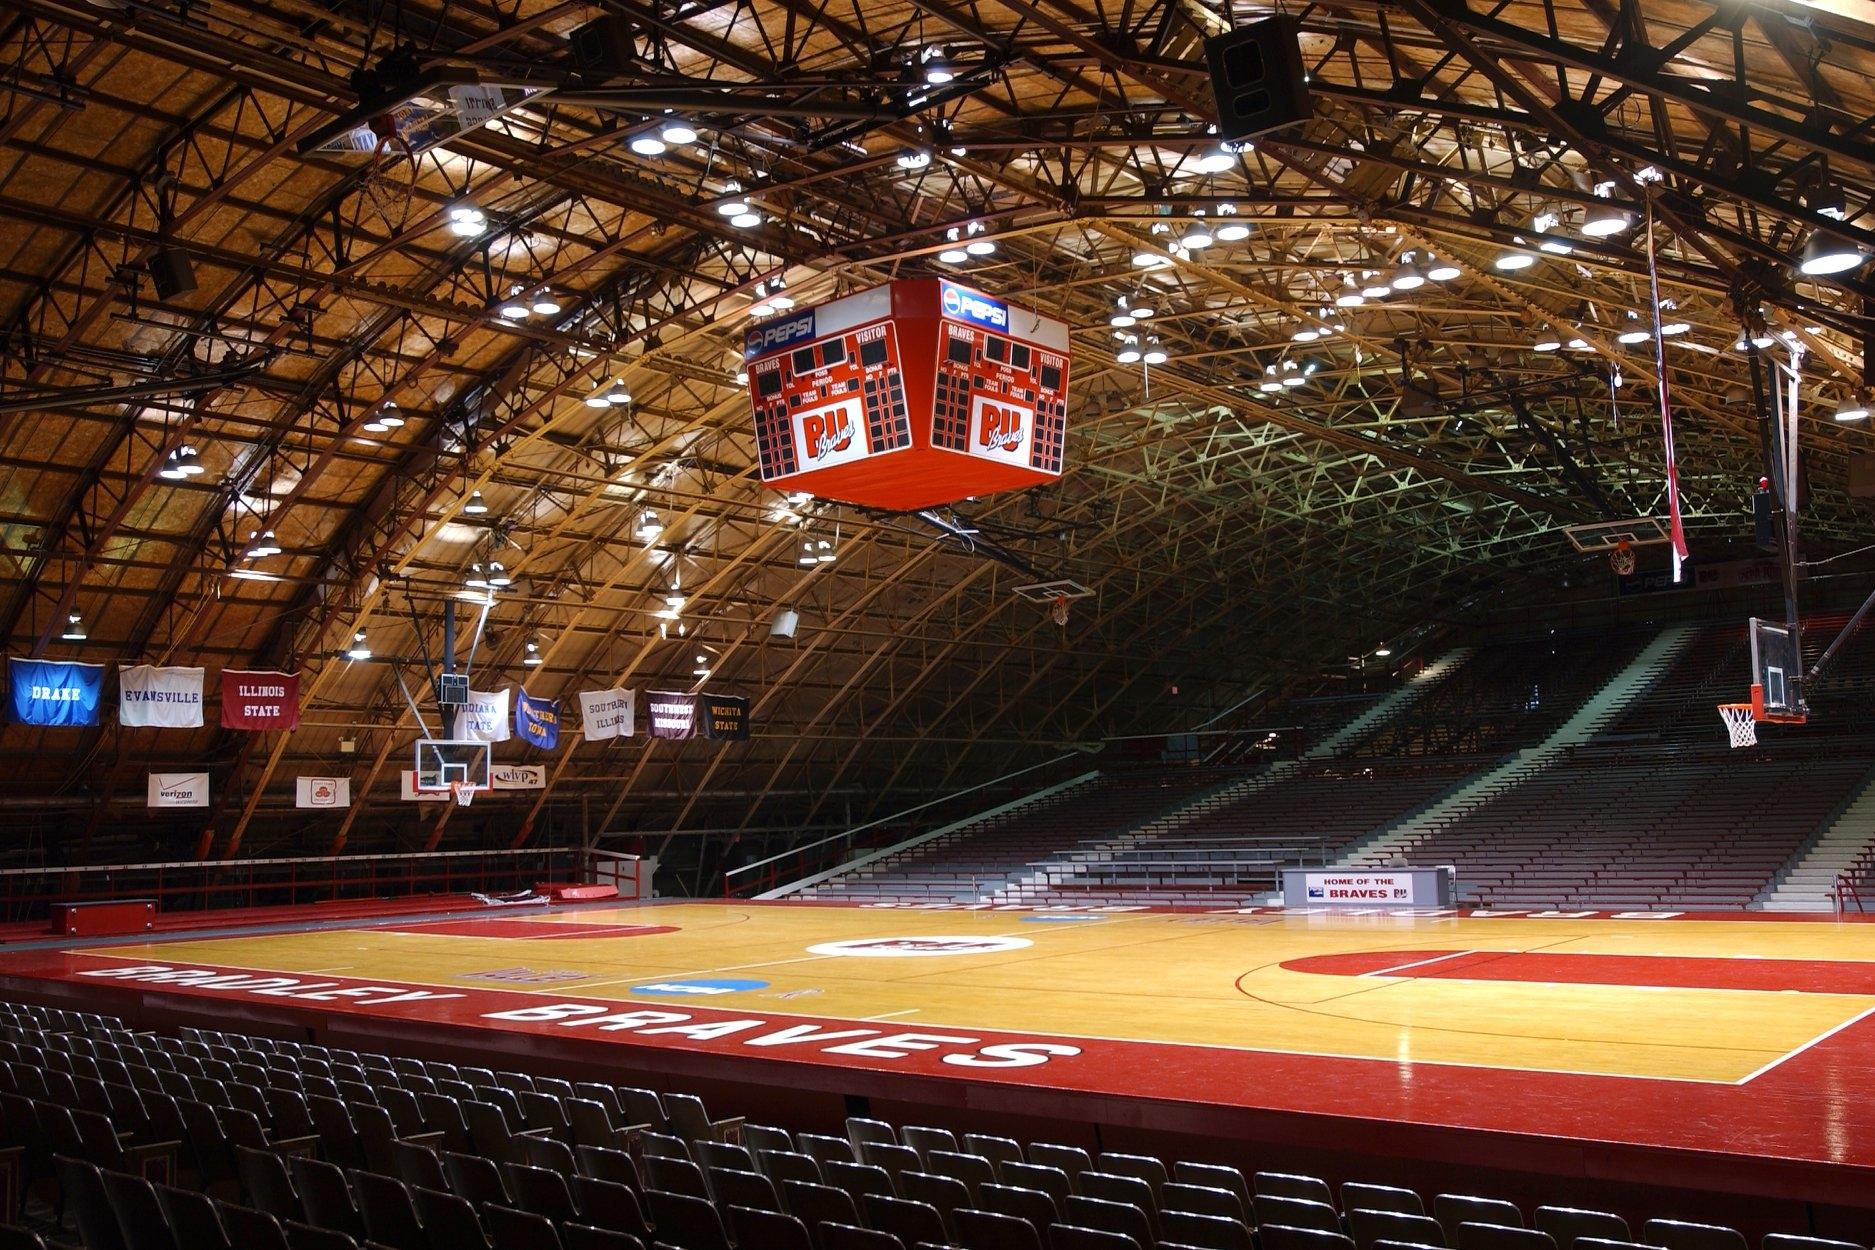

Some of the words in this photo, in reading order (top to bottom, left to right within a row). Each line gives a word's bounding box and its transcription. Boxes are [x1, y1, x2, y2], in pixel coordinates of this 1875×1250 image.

[961, 296, 1006, 327] PEPSI
[763, 315, 814, 348] PEPSI
[855, 326, 887, 344] VISITOR
[948, 325, 974, 342] BRAVES
[755, 358, 780, 374] BRAVES
[1040, 352, 1063, 369] VISITOR
[812, 375, 833, 387] PERIOD
[996, 372, 1014, 384] PERIOD
[817, 419, 855, 461] Braves
[987, 427, 1024, 451] Braves
[32, 685, 81, 701] DRAKE
[125, 690, 199, 705] EVANSVILLE
[238, 685, 285, 698] ILLINOIS
[244, 705, 280, 718] STATE
[462, 703, 497, 714] NDIANA
[712, 705, 742, 717] WICHITA
[467, 720, 493, 730] TATE
[528, 722, 547, 737] IOWA
[714, 722, 738, 731] STATE
[503, 769, 528, 782] wlvp
[160, 789, 193, 799] verizon
[1329, 889, 1388, 898] BRAVES
[75, 965, 467, 1005] BRADLEY
[480, 1003, 1081, 1069] BRAVES
